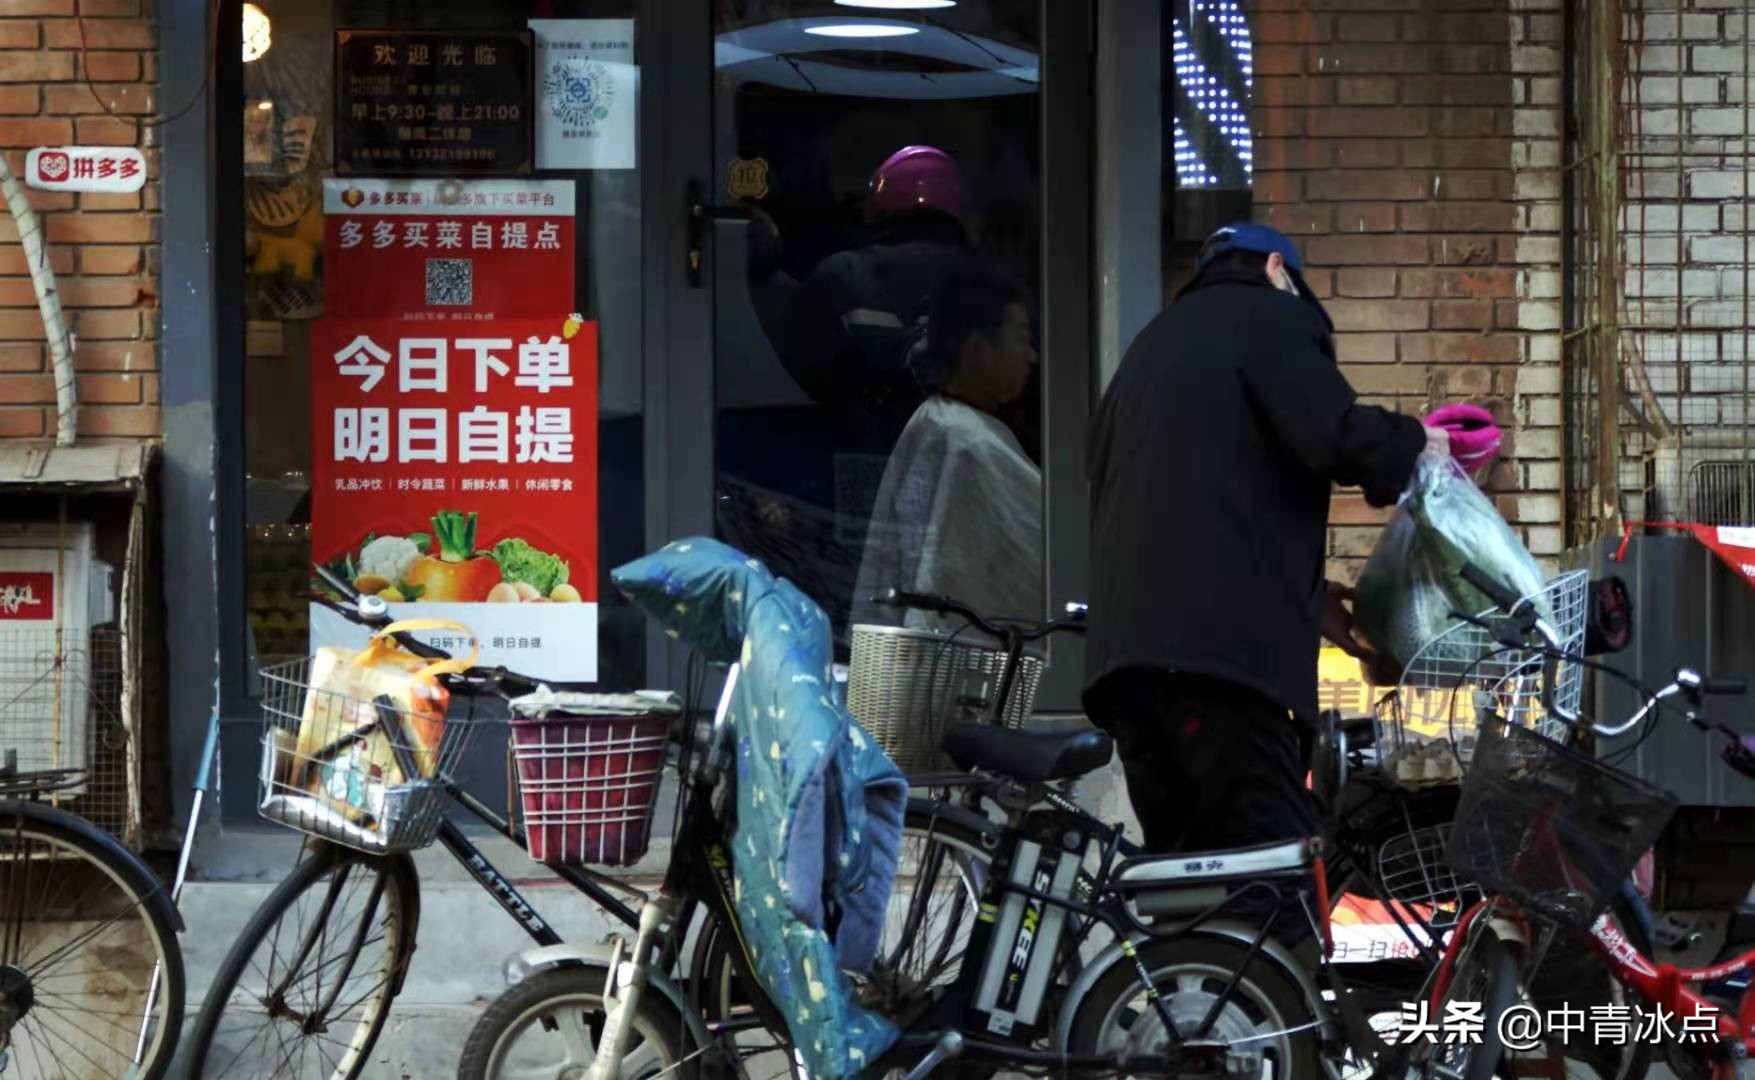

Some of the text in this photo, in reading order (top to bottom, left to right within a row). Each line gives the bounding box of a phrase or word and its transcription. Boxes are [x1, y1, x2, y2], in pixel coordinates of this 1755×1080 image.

[373, 43, 497, 66] 欢迎光临
[73, 157, 140, 179] 拼多多
[434, 191, 555, 207] 多旗下买菜平台
[339, 219, 561, 250] 多多买菜自提点
[333, 335, 574, 393] 今日下单
[333, 405, 574, 464] 明日自提
[335, 478, 574, 491] 乳品冲饮 时令蔬菜 新鲜水果 休闲零食
